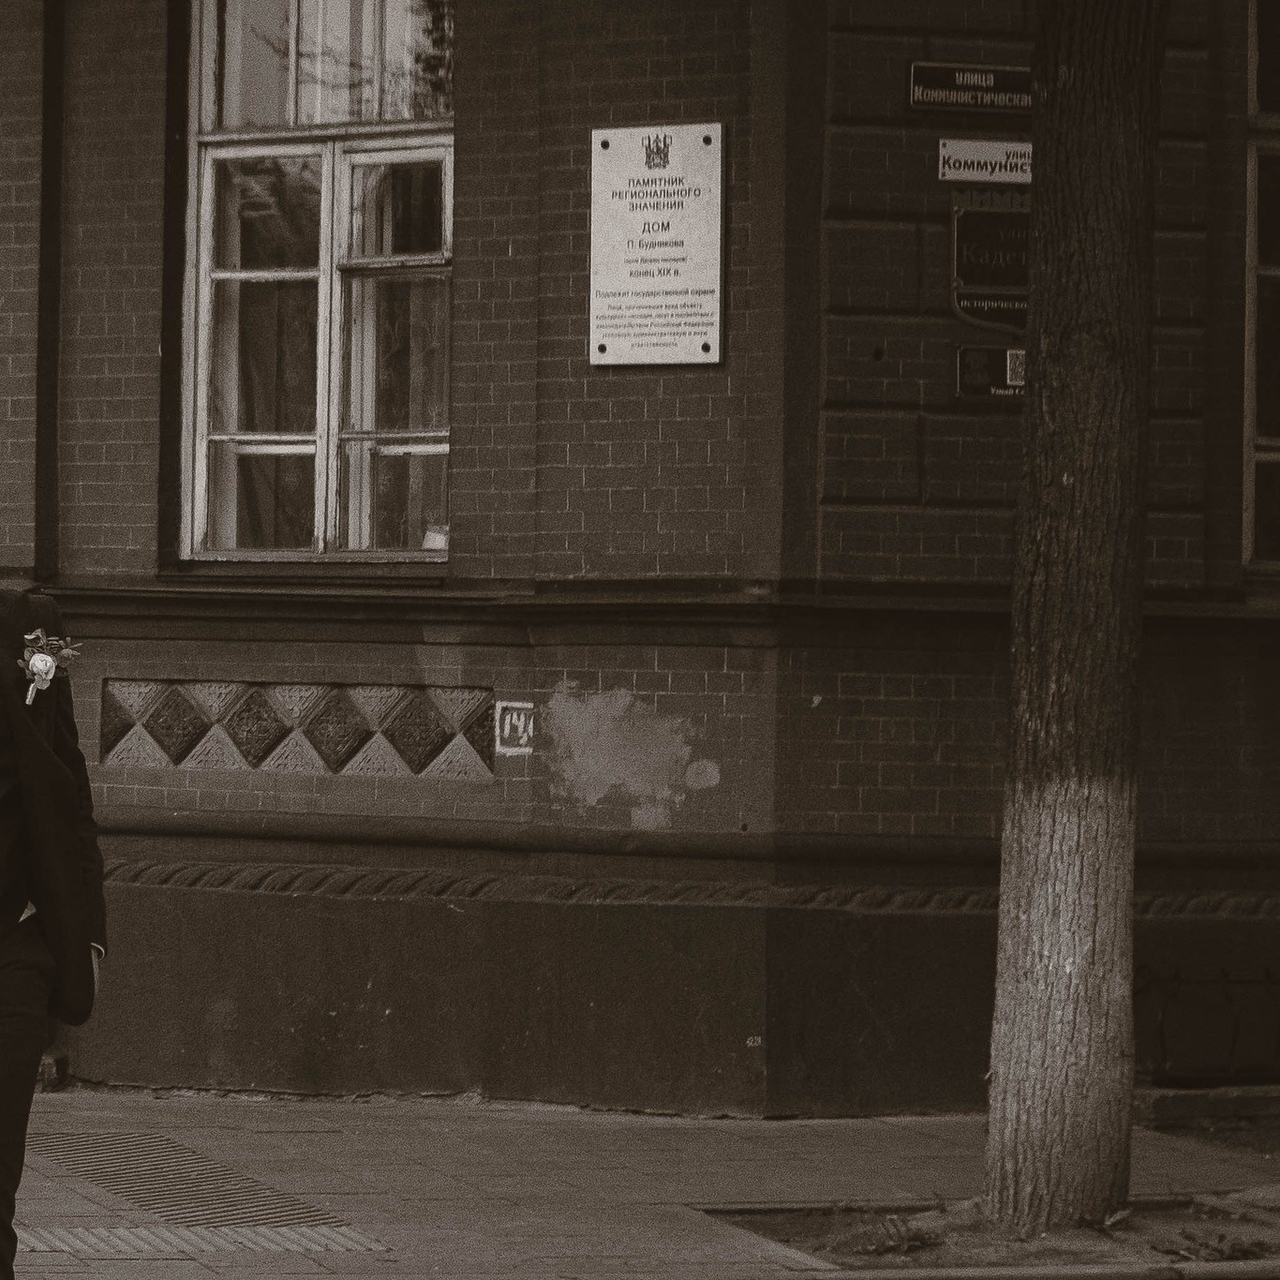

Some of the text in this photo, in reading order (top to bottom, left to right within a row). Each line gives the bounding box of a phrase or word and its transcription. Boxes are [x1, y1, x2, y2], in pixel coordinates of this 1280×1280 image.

[941, 156, 1031, 176] Коммунис
[628, 177, 685, 187] ПАМЯТНИК
[611, 188, 701, 200] РЕГИОНАЛЬНОГО
[629, 201, 684, 212] ЗНАЧЕНИЯ
[642, 221, 670, 234] ДОМ
[638, 239, 685, 250] Будникова
[629, 269, 655, 278] конец
[656, 268, 672, 277] XIX
